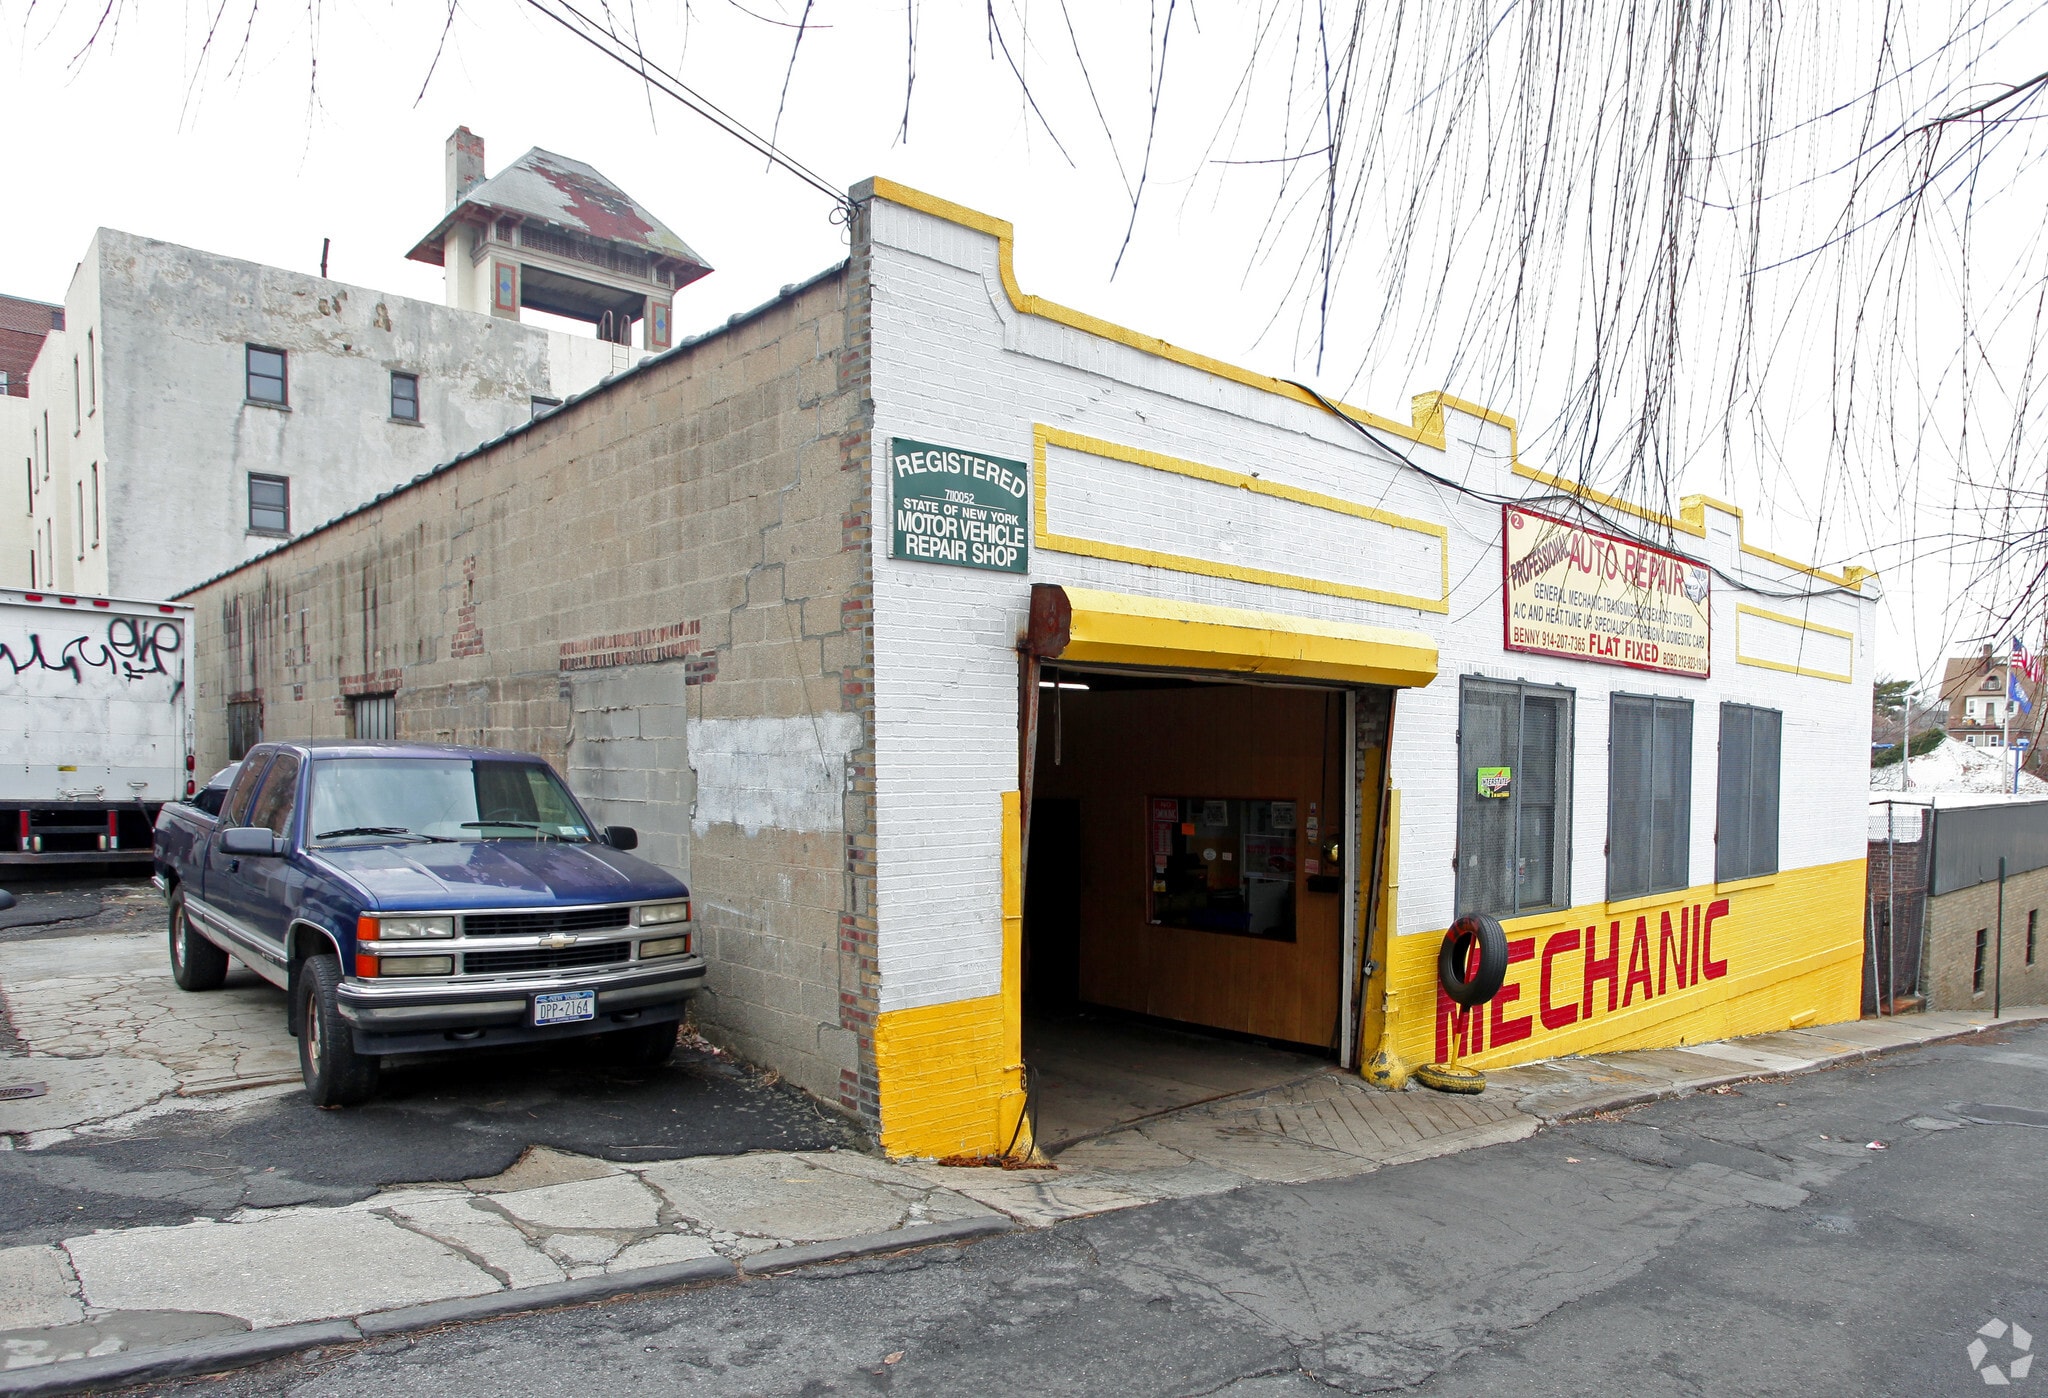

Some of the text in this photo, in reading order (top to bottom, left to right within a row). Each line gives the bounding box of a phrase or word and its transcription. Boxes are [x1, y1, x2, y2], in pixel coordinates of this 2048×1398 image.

[895, 451, 1026, 498] REGISTERED
[897, 510, 1025, 548] MOTOR VEHICLE
[903, 498, 1019, 526] STATE OF NEW YORK
[1514, 516, 1520, 526] 2
[906, 534, 1018, 567] REPAIR SHOP
[1510, 533, 1571, 591] PROFESSIONAL
[1568, 533, 1685, 597] AUTO REPAIR
[1533, 582, 1567, 604] GENERAL
[1673, 612, 1693, 629] SYSTEM
[1513, 602, 1527, 619] A/C
[1528, 604, 1543, 622] AND
[1564, 610, 1582, 628] TUNE
[1594, 616, 1629, 637] SPECIALIST
[1630, 622, 1636, 638] IN
[1666, 629, 1691, 647] DOMESTIC
[1692, 634, 1705, 650] CARS
[1513, 626, 1586, 652] BENNY 914-207-7365
[1589, 633, 1659, 663] FLAT FIXED
[1663, 652, 1678, 667] BOBO
[1435, 899, 1730, 1064] MECHANIC
